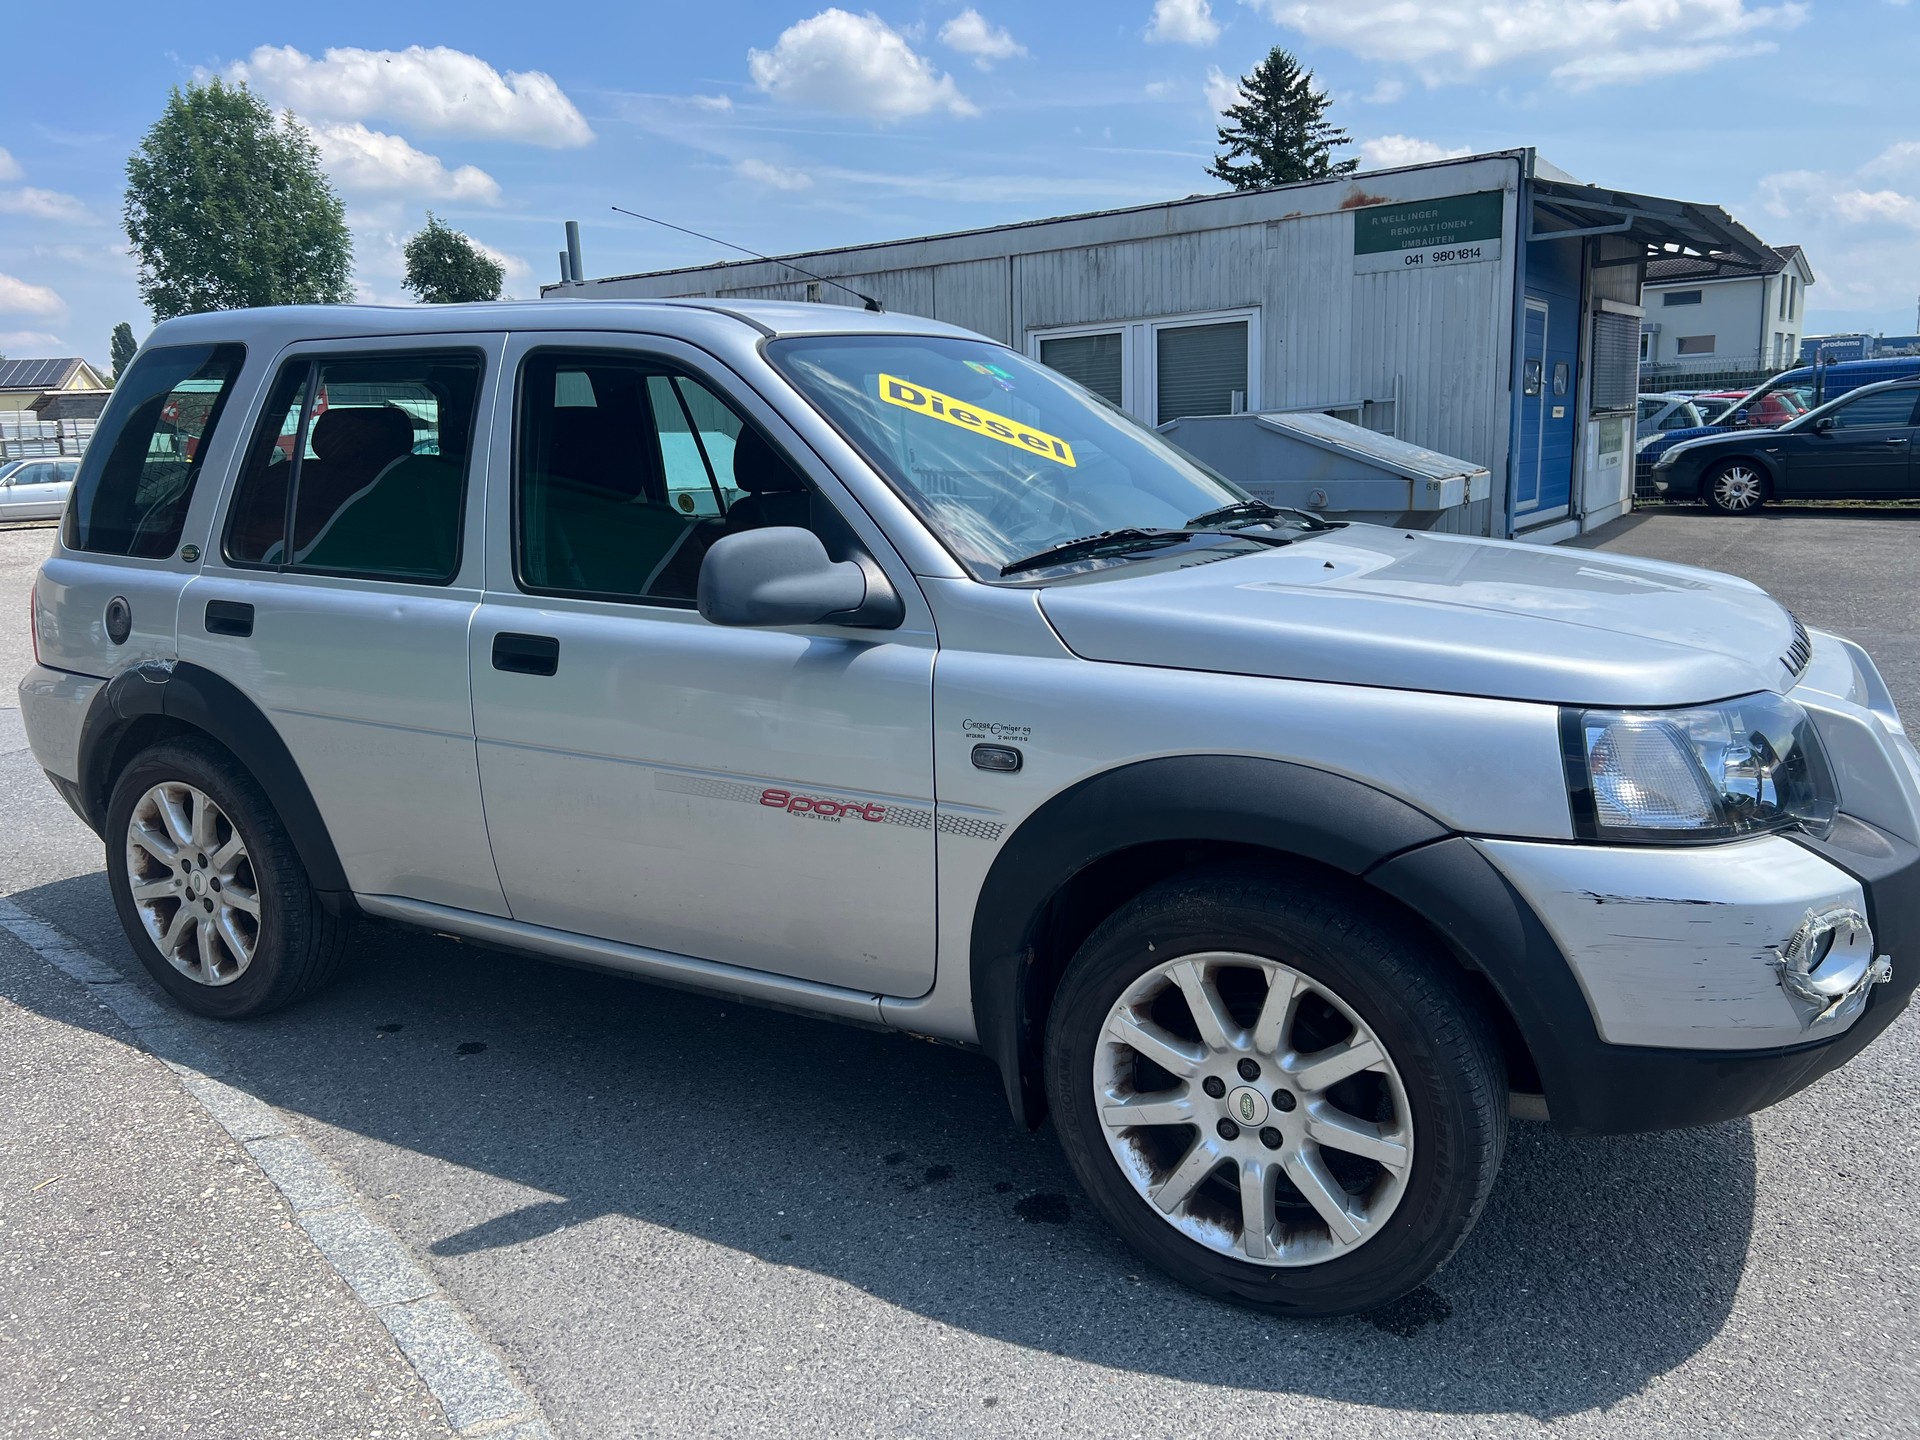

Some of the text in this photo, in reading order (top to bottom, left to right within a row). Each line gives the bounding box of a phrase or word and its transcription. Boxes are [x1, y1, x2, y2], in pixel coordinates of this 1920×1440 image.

[1371, 217, 1378, 225] R
[1390, 219, 1467, 236] RENOVATIONEN
[1401, 235, 1455, 248] UMBAUTEN
[1404, 254, 1424, 265] 041
[1821, 340, 1860, 349] proderma
[888, 380, 1067, 460] Diesel
[760, 788, 886, 823] Sport
[793, 811, 841, 823] SYSTEM
